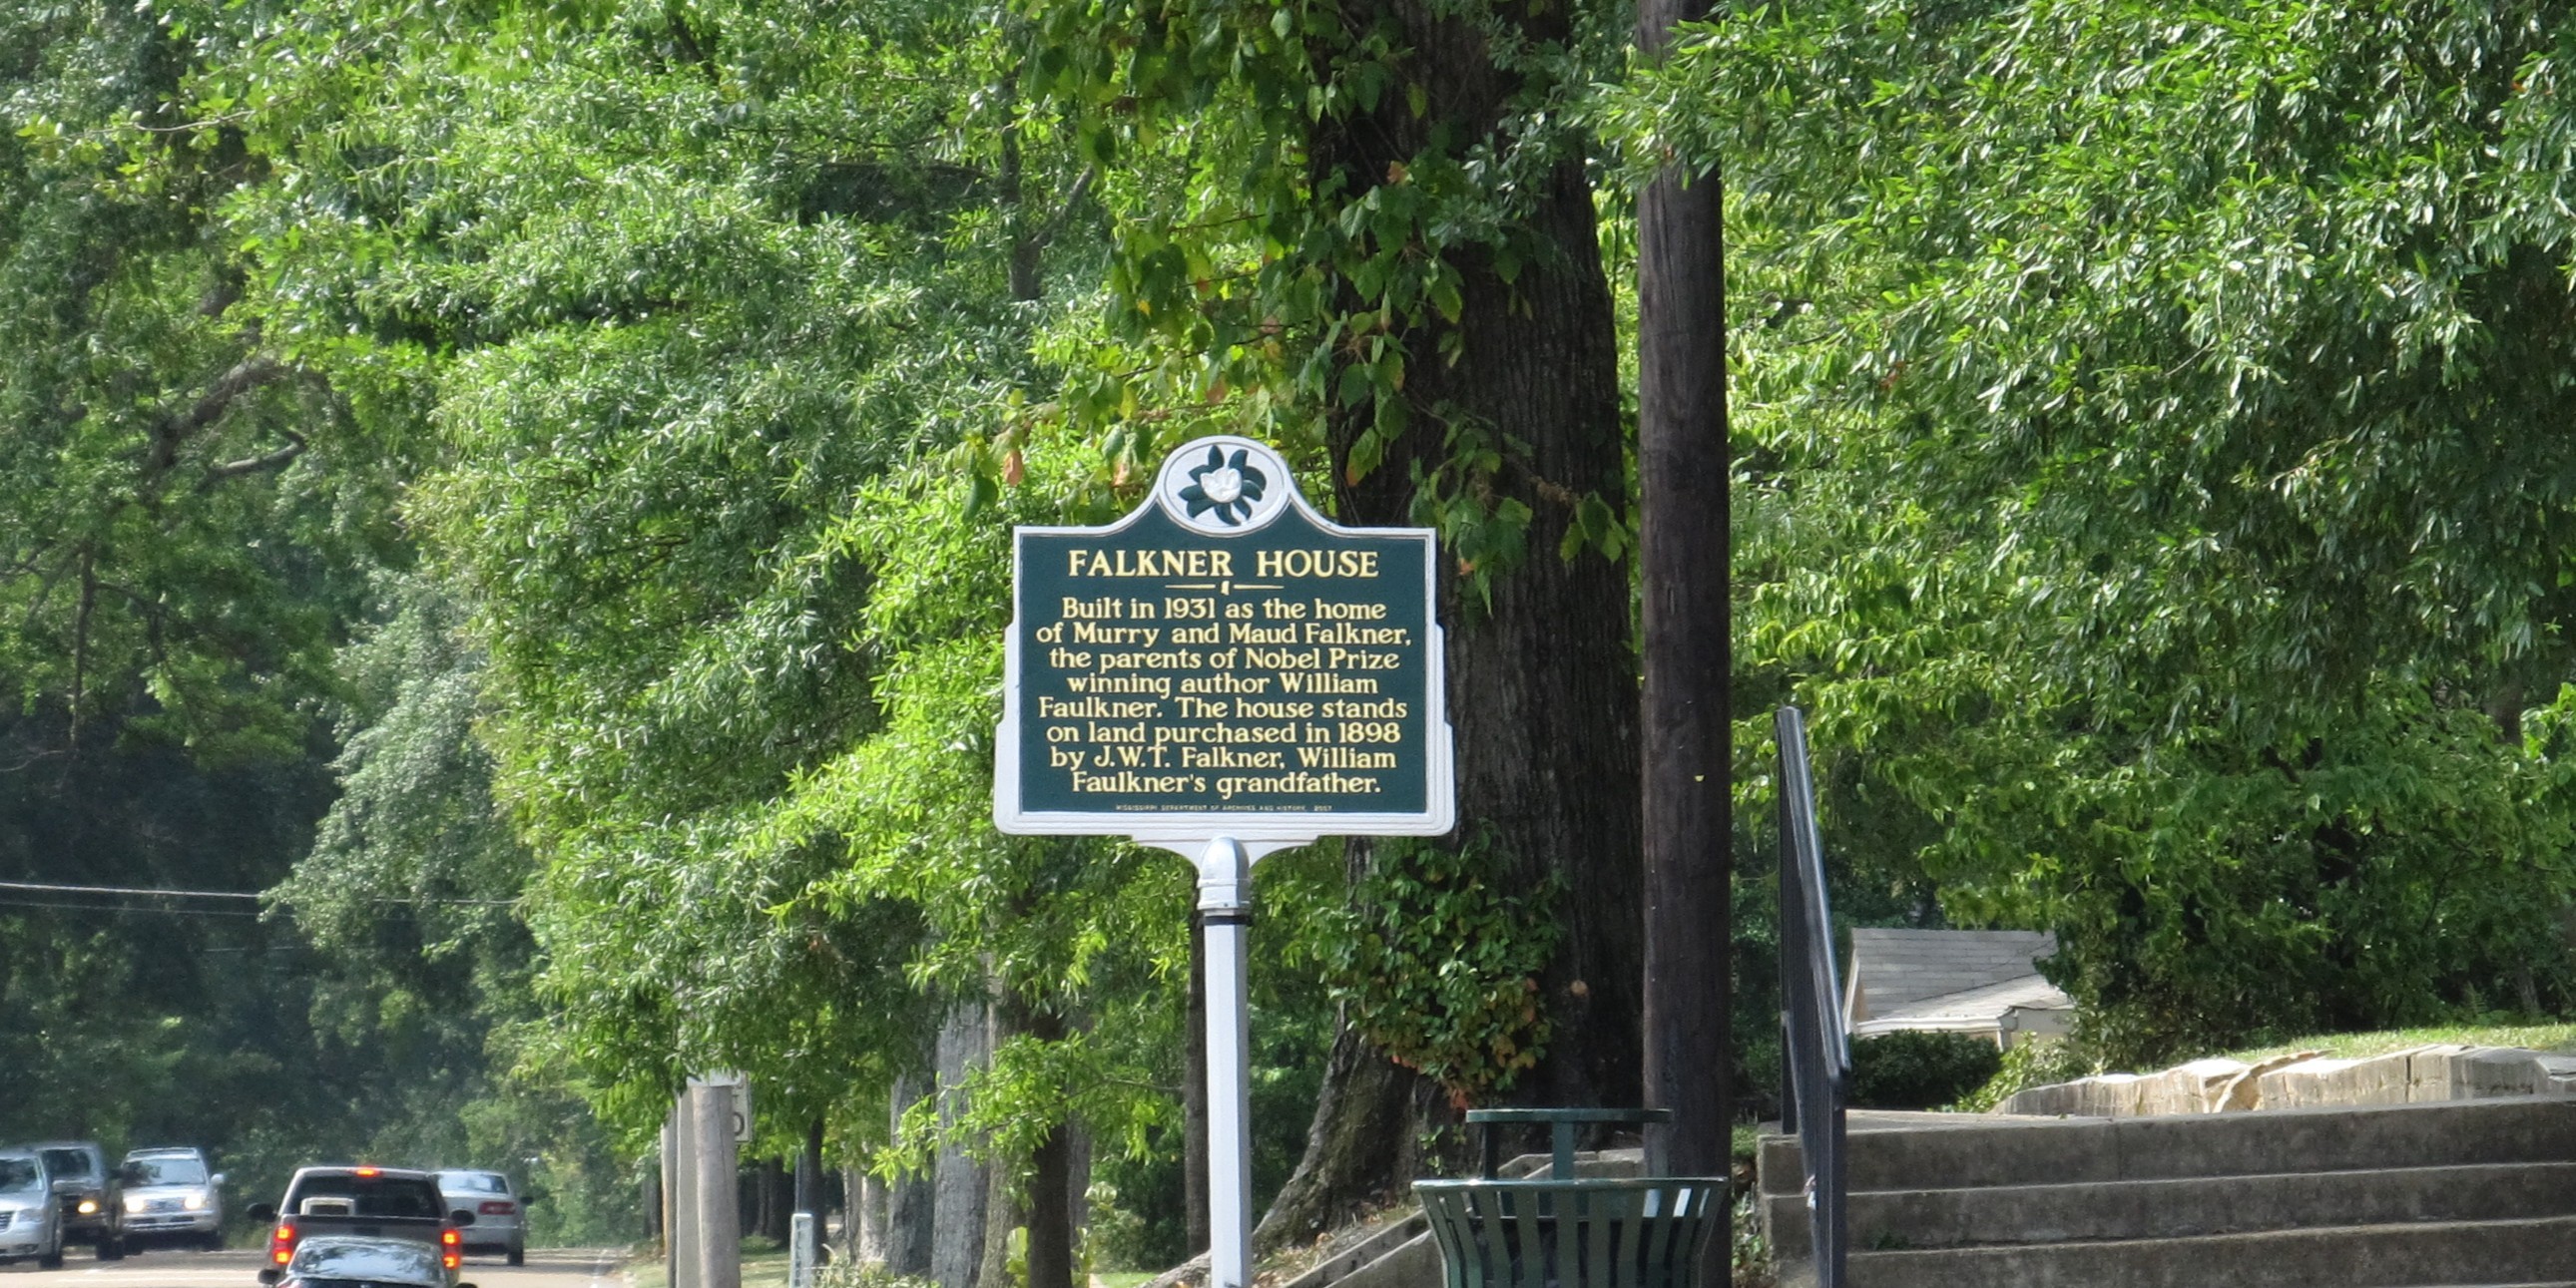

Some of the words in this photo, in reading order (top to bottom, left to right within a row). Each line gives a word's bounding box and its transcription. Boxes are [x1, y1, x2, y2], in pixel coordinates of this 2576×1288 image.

[1069, 550, 1235, 578] FALKNER
[1256, 551, 1379, 578] HOUSE
[1062, 598, 1123, 620] Built
[1131, 599, 1155, 620] in
[1165, 598, 1215, 620] 1931
[1225, 603, 1254, 620] as
[1263, 598, 1305, 620] the
[1314, 599, 1386, 620] home
[1036, 622, 1064, 644] of
[1073, 622, 1160, 647] Murry
[1172, 623, 1220, 644] and
[1229, 623, 1297, 644] Maud
[1305, 623, 1410, 645] Falkner,
[1049, 647, 1092, 668] the
[1100, 648, 1202, 674] parents
[1210, 647, 1238, 668] of
[1246, 647, 1320, 668] Nobel
[1328, 647, 1400, 669] Prize
[1067, 672, 1171, 699] winning
[1181, 672, 1272, 693] author
[1279, 672, 1377, 693] William
[1038, 696, 1163, 718] Faulkner.
[1175, 696, 1228, 718] The
[1236, 696, 1314, 718] house
[1321, 697, 1407, 718] stands
[1046, 726, 1080, 743] on
[1089, 721, 1146, 743] land
[1155, 721, 1296, 748] purchased
[1305, 722, 1330, 743] in
[1338, 721, 1401, 743] 1898
[1051, 746, 1085, 771] by
[1094, 745, 1171, 768] J.W.T.
[1182, 746, 1286, 769] Falkner,
[1296, 746, 1396, 769] William
[1072, 771, 1206, 793] Faulkner's
[1217, 771, 1381, 798] grandfather.
